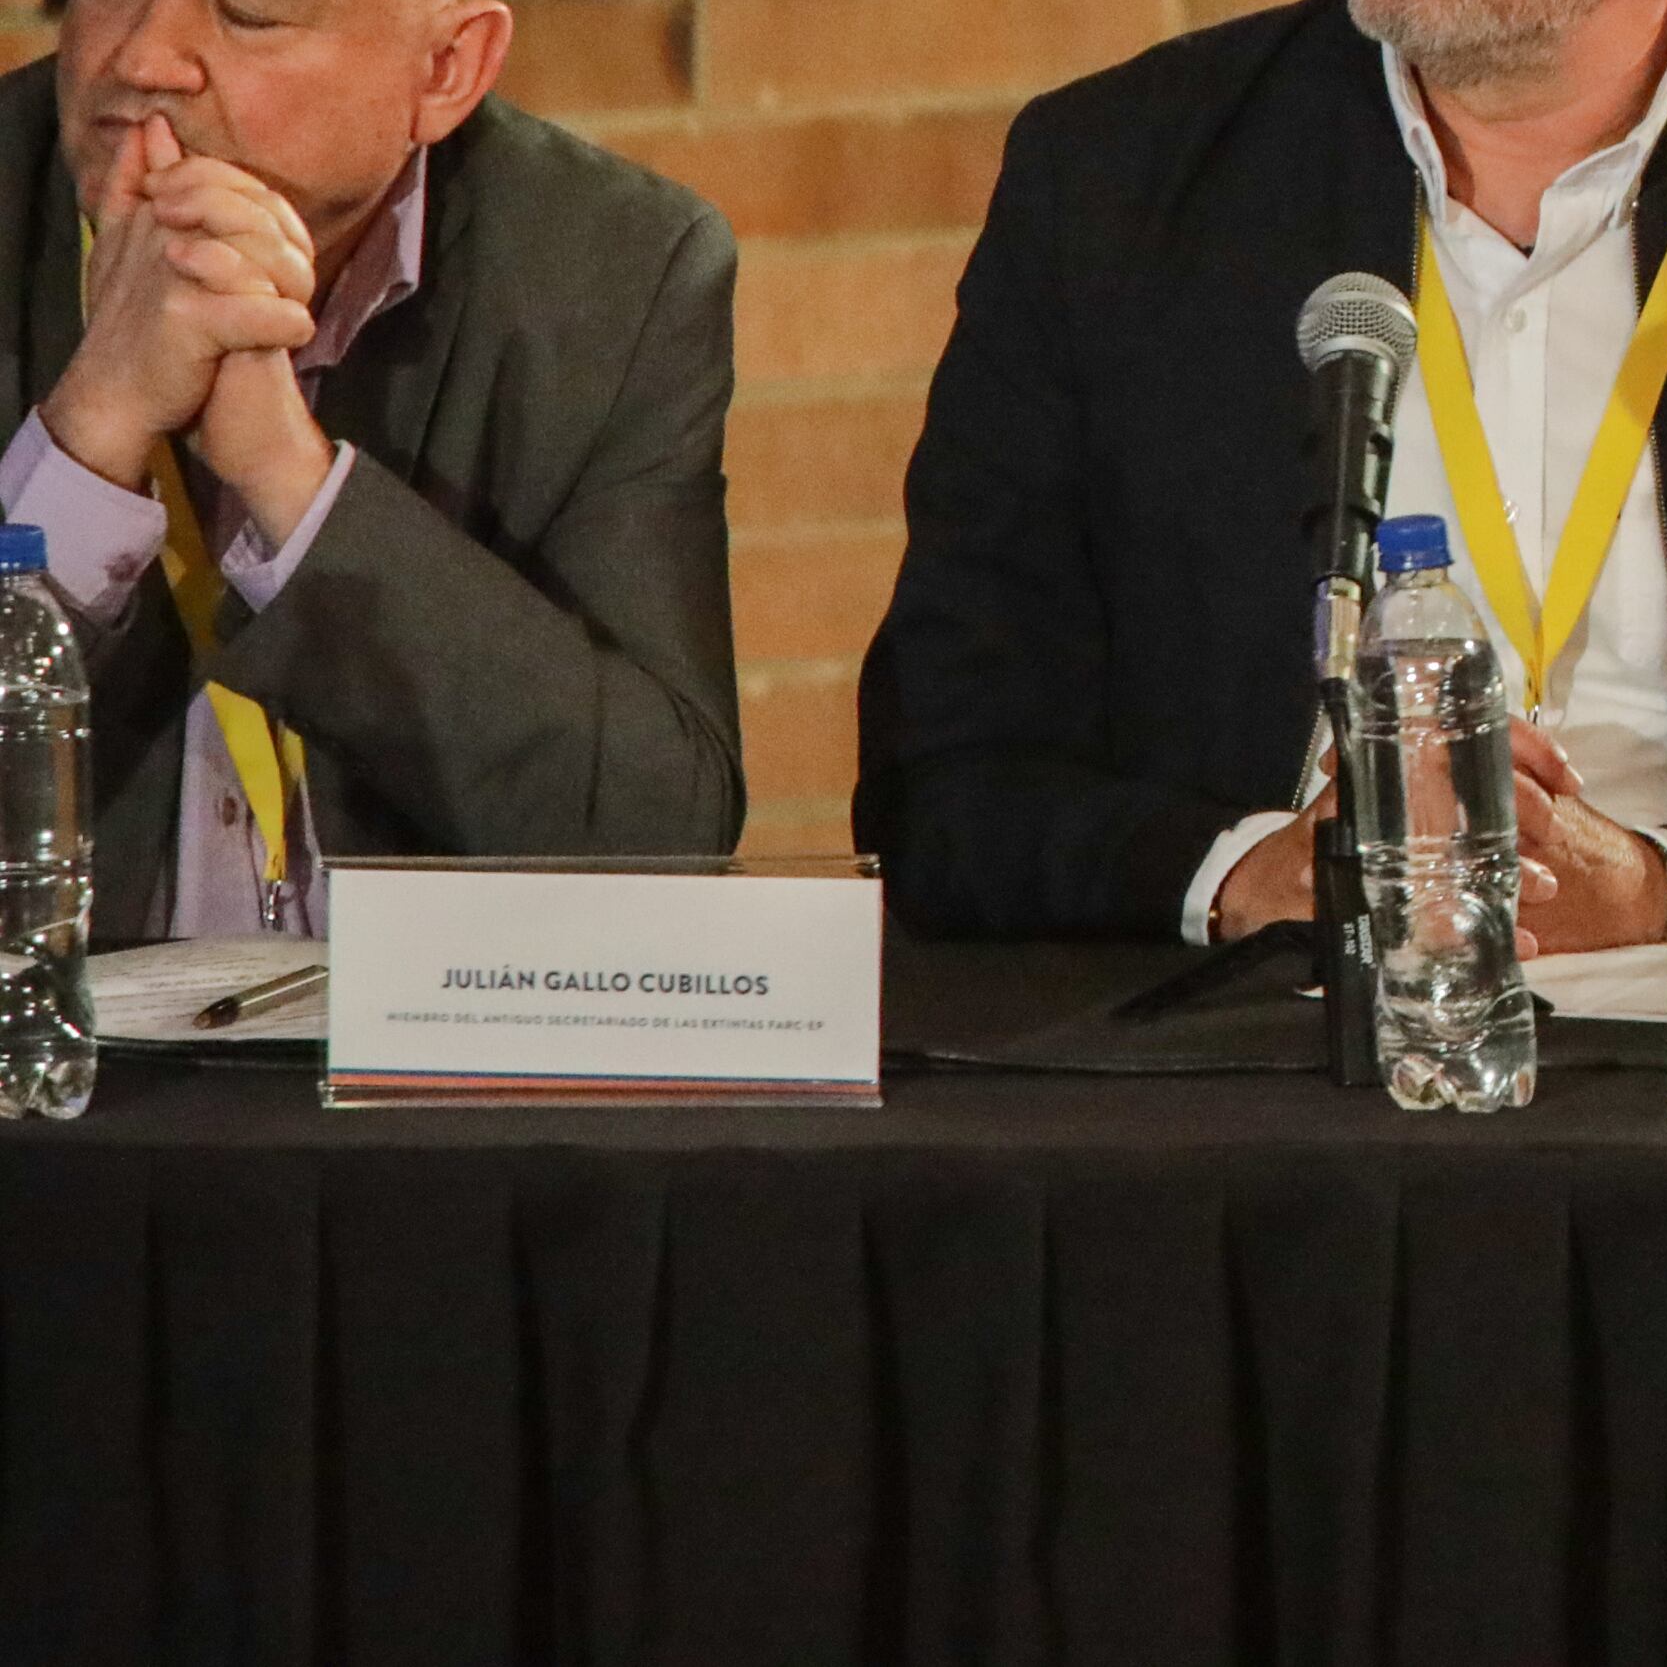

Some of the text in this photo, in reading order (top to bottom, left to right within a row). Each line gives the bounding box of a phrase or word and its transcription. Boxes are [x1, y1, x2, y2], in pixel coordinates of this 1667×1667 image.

[441, 965, 770, 996] JULIÁN GALLO CUBILLOS
